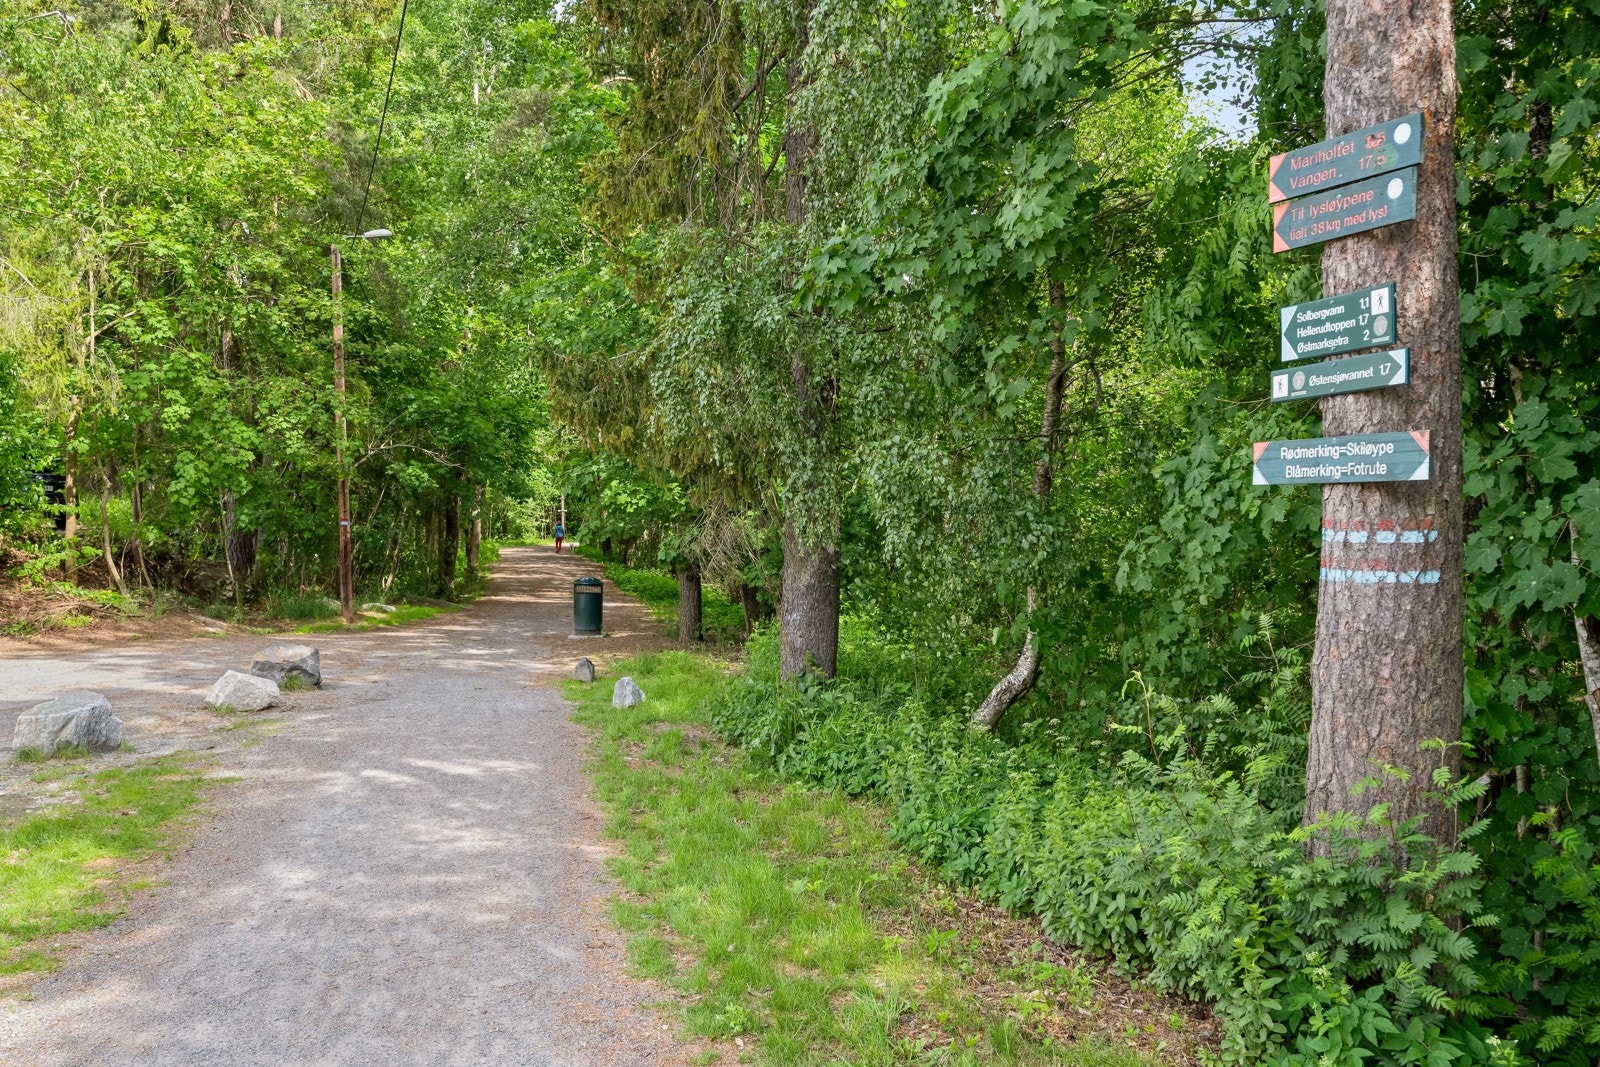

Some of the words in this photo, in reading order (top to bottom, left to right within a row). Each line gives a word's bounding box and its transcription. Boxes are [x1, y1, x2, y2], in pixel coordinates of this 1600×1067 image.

[1290, 140, 1355, 171] Mariholtet
[1290, 167, 1337, 190] Vangen
[1291, 208, 1304, 221] Til
[1309, 190, 1374, 218] lysløypene
[1343, 210, 1366, 227] med
[1369, 205, 1387, 221] lys)
[1296, 305, 1345, 323] Solbergvann
[1296, 319, 1356, 338] Hellerudtoppen
[1358, 313, 1370, 327] 1,7
[1296, 336, 1349, 354] Østmarksetra
[1363, 330, 1370, 341] 2
[1309, 366, 1374, 387] Østensjøvannet
[1378, 363, 1392, 376] 1,7
